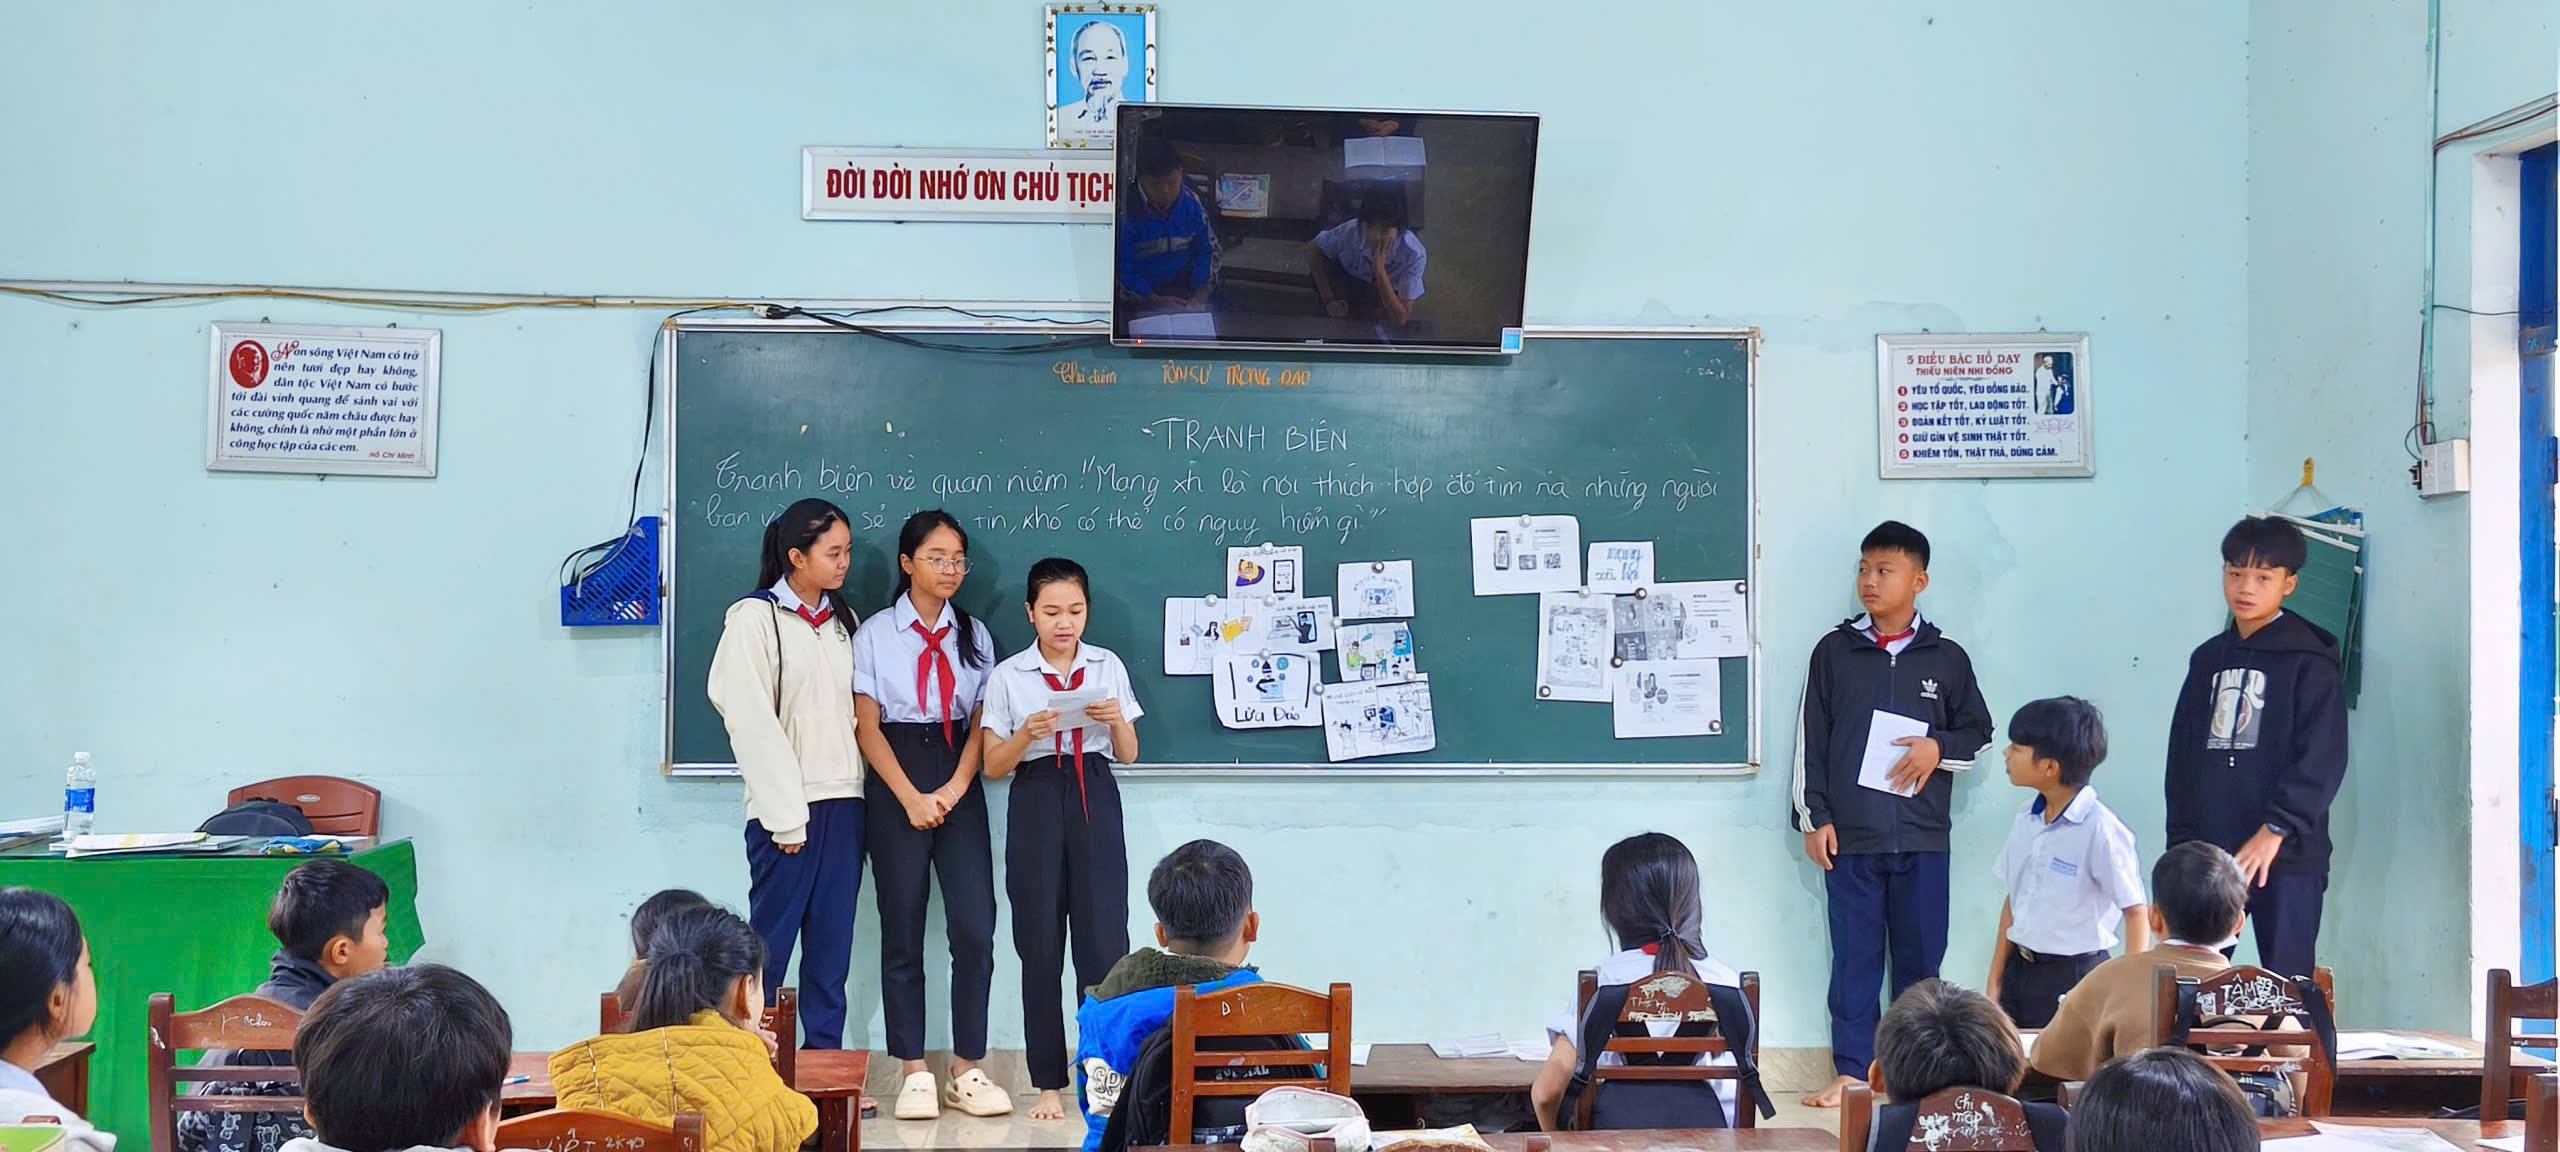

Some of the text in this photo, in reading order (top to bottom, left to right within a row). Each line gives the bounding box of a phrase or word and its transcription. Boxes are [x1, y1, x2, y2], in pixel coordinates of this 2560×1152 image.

[826, 161, 866, 199] ĐỜI
[872, 162, 912, 200] ĐỜI
[919, 163, 970, 201] NHỚ
[973, 168, 1006, 201] ƠN
[1013, 161, 1060, 202] CHỦ
[309, 347, 334, 360] sông
[336, 348, 359, 360] Việt
[360, 349, 386, 360] Nam
[387, 350, 401, 360] có
[1906, 354, 1914, 365] 5
[1949, 352, 1973, 364] BÁC
[1976, 349, 1993, 364] HỒ
[1997, 353, 2021, 366] DẠY
[273, 362, 418, 379] nên tươi đẹp hay không,
[1943, 365, 1966, 376] NIÊN
[1967, 367, 1984, 375] NHI
[273, 377, 419, 392] dân tộc Việt Nam có bước
[1911, 383, 1927, 395] YÊU
[1969, 383, 1985, 395] YÊU
[1986, 381, 2009, 394] ĐỒNG
[231, 391, 247, 401] tới
[250, 391, 267, 402] đài
[298, 395, 331, 406] quang
[334, 394, 350, 405] để
[352, 395, 378, 406] sánh
[381, 397, 398, 407] vai
[401, 397, 418, 408] với
[1911, 401, 1929, 412] HỌC
[1931, 400, 1947, 412] TẬP
[1969, 401, 1985, 410] LAO
[1987, 400, 2010, 412] ĐỘNG
[230, 408, 418, 425] các cường quốc năm châu được hay
[1936, 413, 1952, 427] KẾT
[1988, 414, 2009, 427] LUẬT
[230, 422, 266, 436] không,
[267, 423, 298, 435] chính
[299, 424, 309, 435] là
[311, 424, 334, 436] nhờ
[335, 425, 357, 438] một
[359, 426, 387, 440] phần
[389, 427, 407, 438] lớn
[1948, 431, 1960, 443] VỆ
[1961, 432, 1983, 442] SINH
[1984, 431, 2007, 443] THẬT
[229, 438, 359, 452] công học tập của các em.
[1912, 446, 1941, 458] KHIÊM
[1964, 447, 1987, 459] THẬT
[2010, 446, 2034, 457] DŨNG
[715, 451, 802, 493] Tranh
[932, 470, 993, 502] quan
[1221, 467, 1250, 495] là
[1077, 505, 1102, 532] có
[1162, 504, 1188, 532] có
[1199, 516, 1259, 546] nguy
